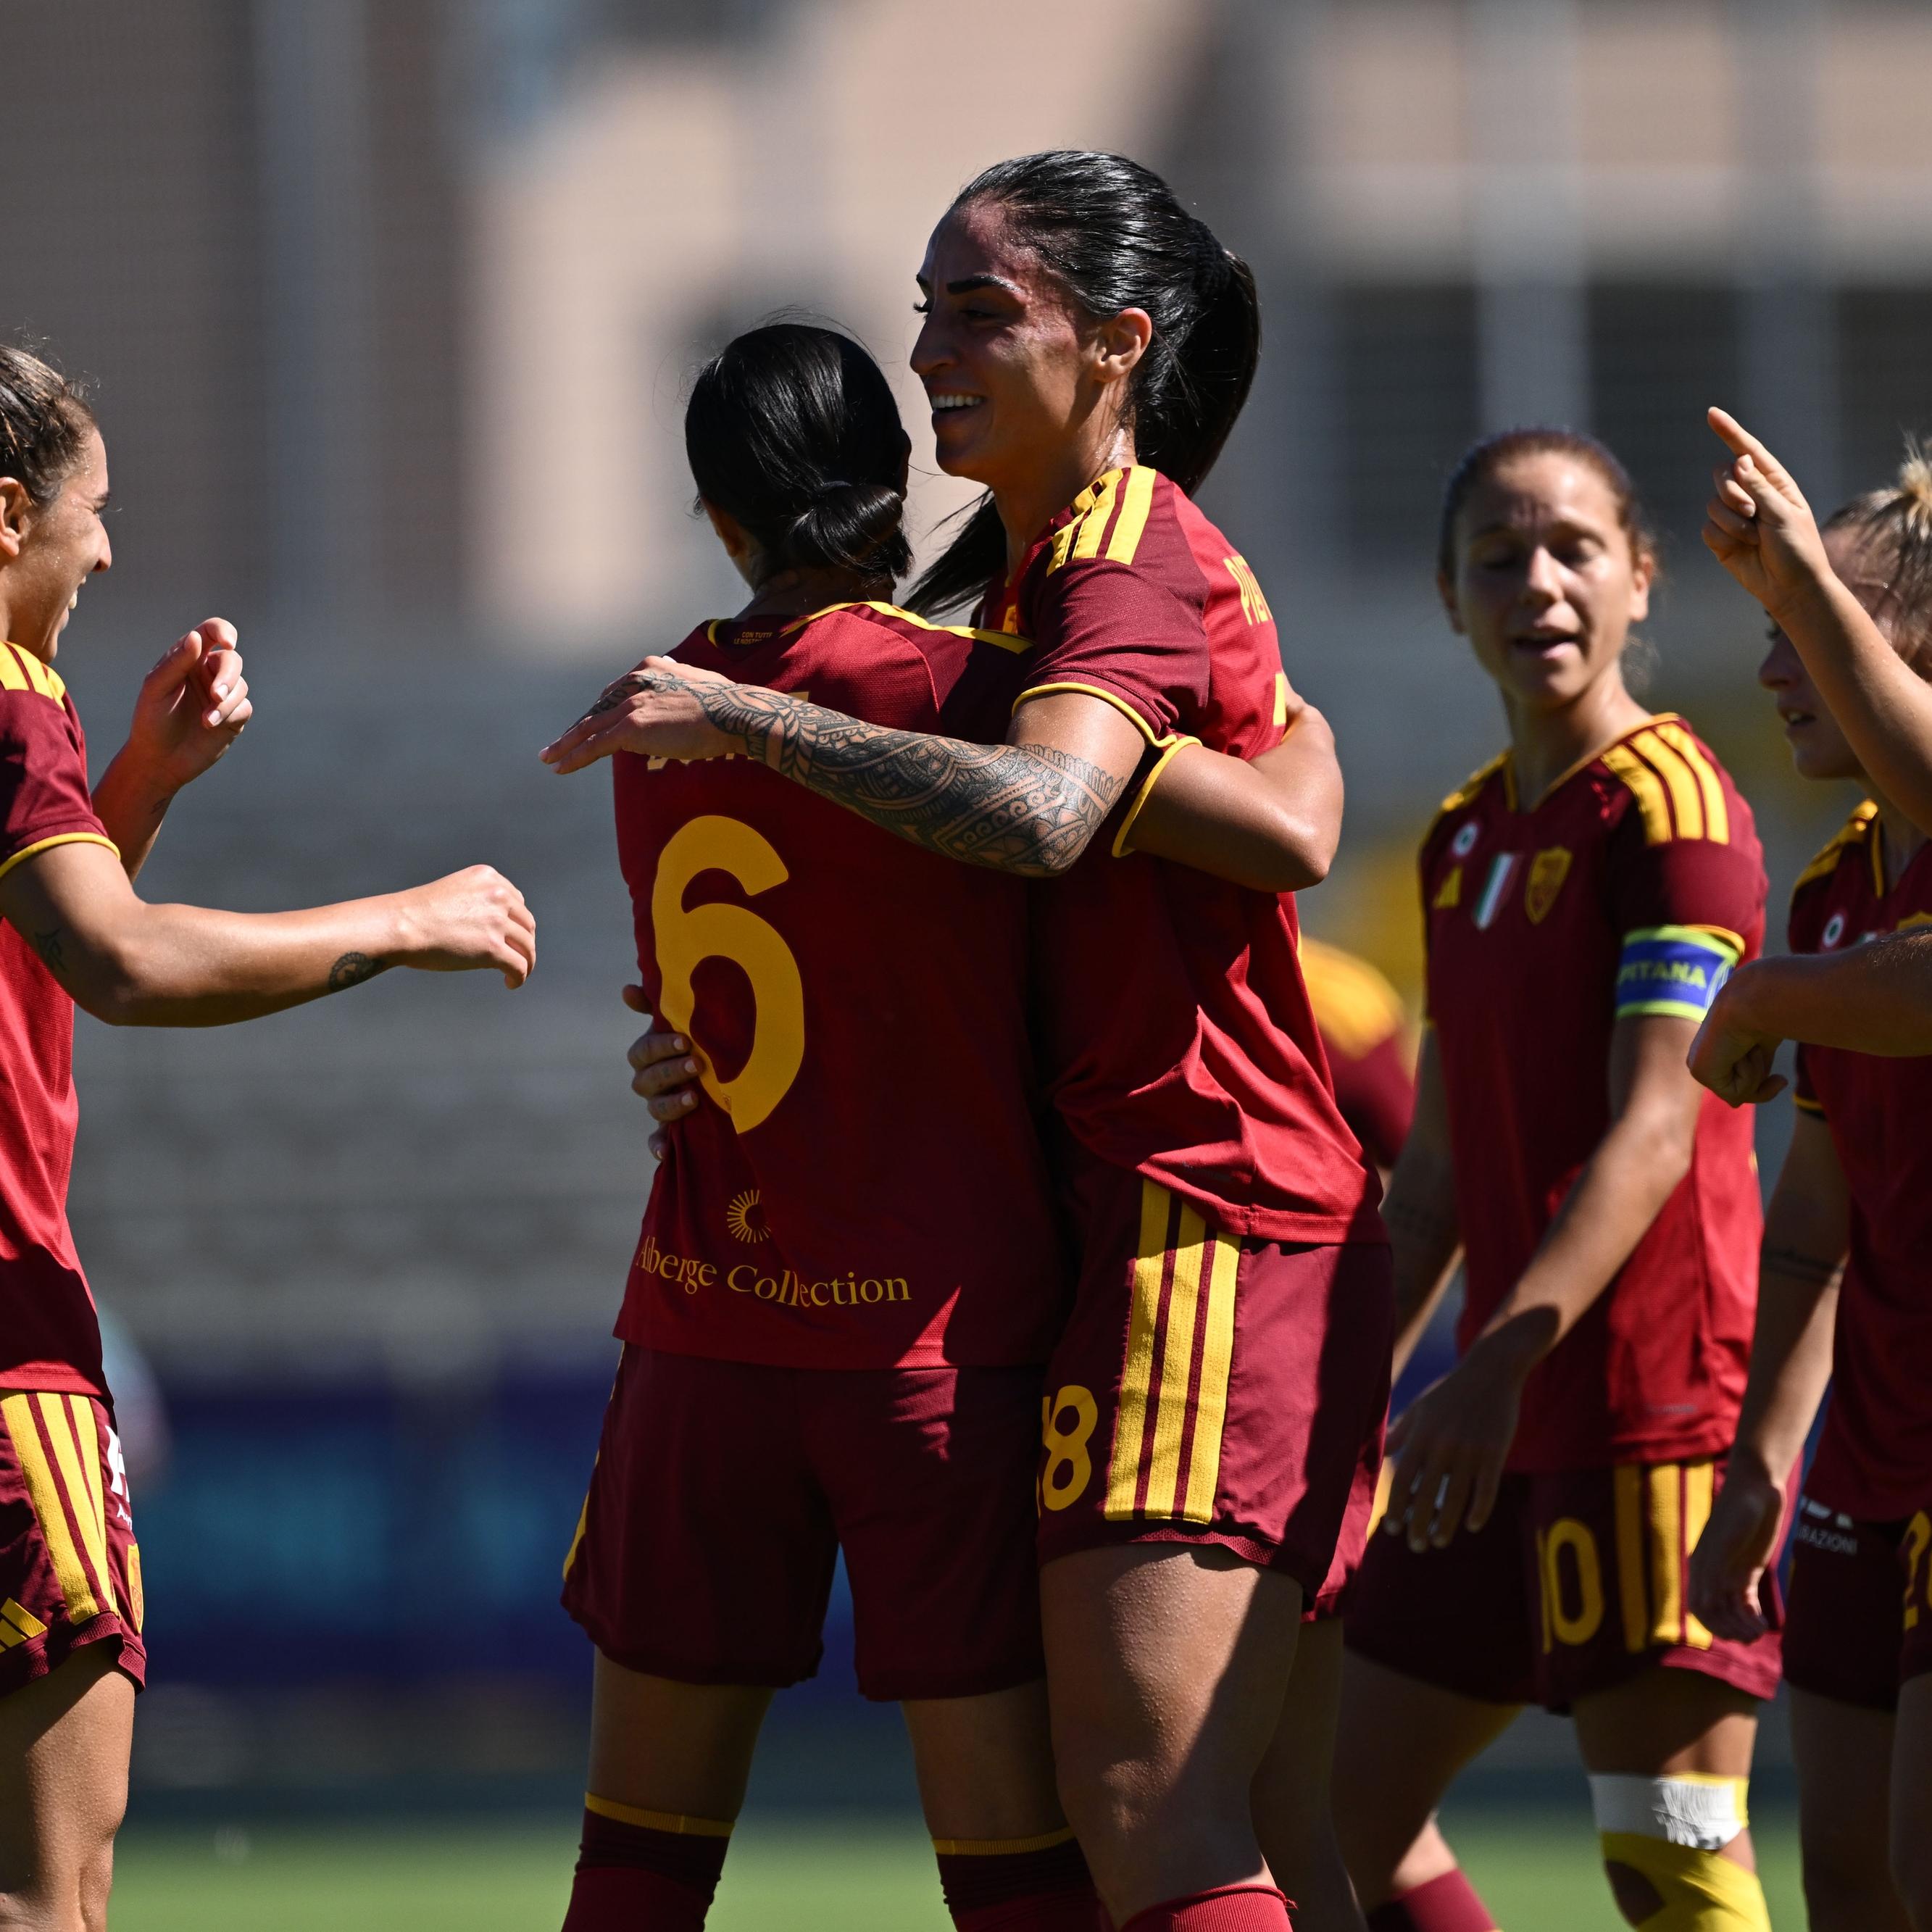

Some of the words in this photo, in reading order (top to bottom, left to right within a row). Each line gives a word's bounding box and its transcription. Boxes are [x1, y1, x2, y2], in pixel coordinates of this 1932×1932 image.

[651, 815, 805, 1135] 6
[727, 1264, 912, 1308] Collection
[1902, 1510, 1932, 1631] 2
